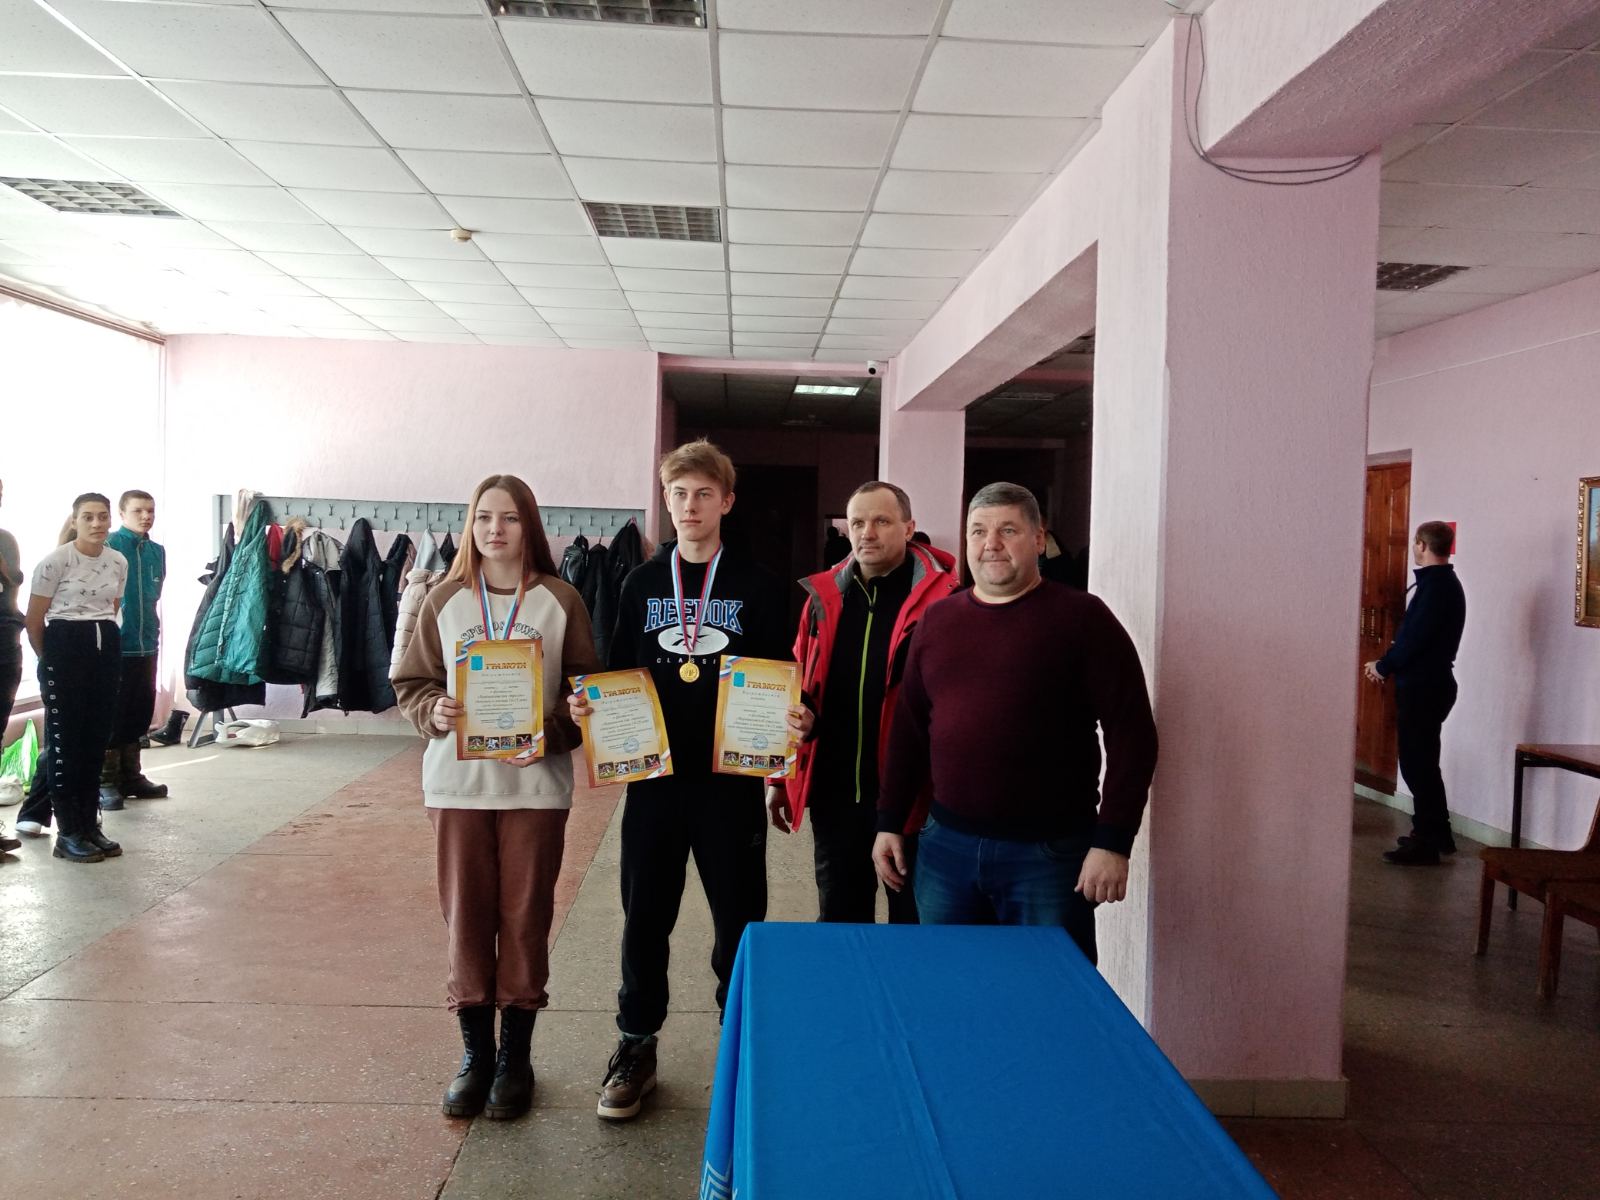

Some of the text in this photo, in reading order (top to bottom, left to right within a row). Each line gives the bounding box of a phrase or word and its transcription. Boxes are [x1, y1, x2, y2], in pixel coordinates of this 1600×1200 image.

[656, 657, 717, 665] CLASSI
[485, 662, 527, 671] ГРАМОТА
[746, 680, 787, 691] ГРАМОТА
